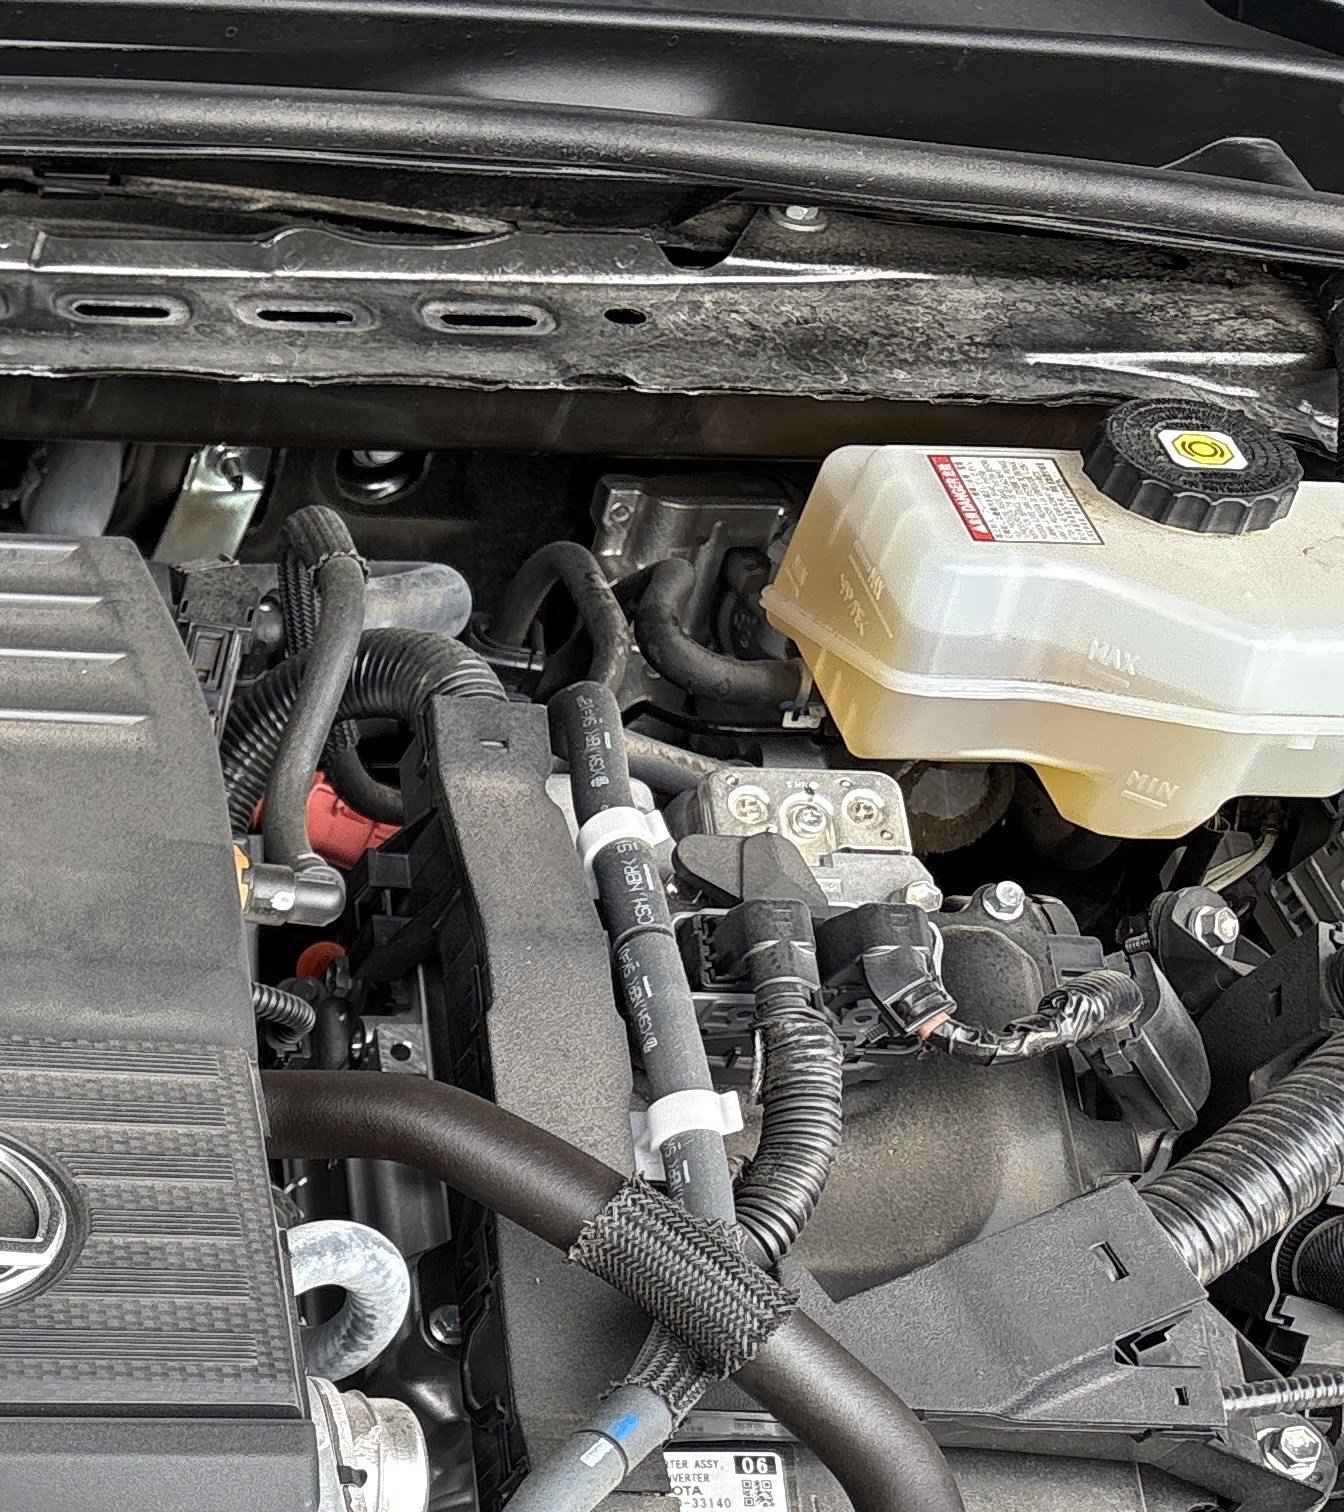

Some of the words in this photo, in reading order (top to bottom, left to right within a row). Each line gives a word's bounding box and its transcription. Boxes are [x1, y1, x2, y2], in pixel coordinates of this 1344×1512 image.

[1088, 638, 1140, 675] MAX
[1125, 769, 1180, 801] MIN
[741, 1457, 769, 1474] 06
